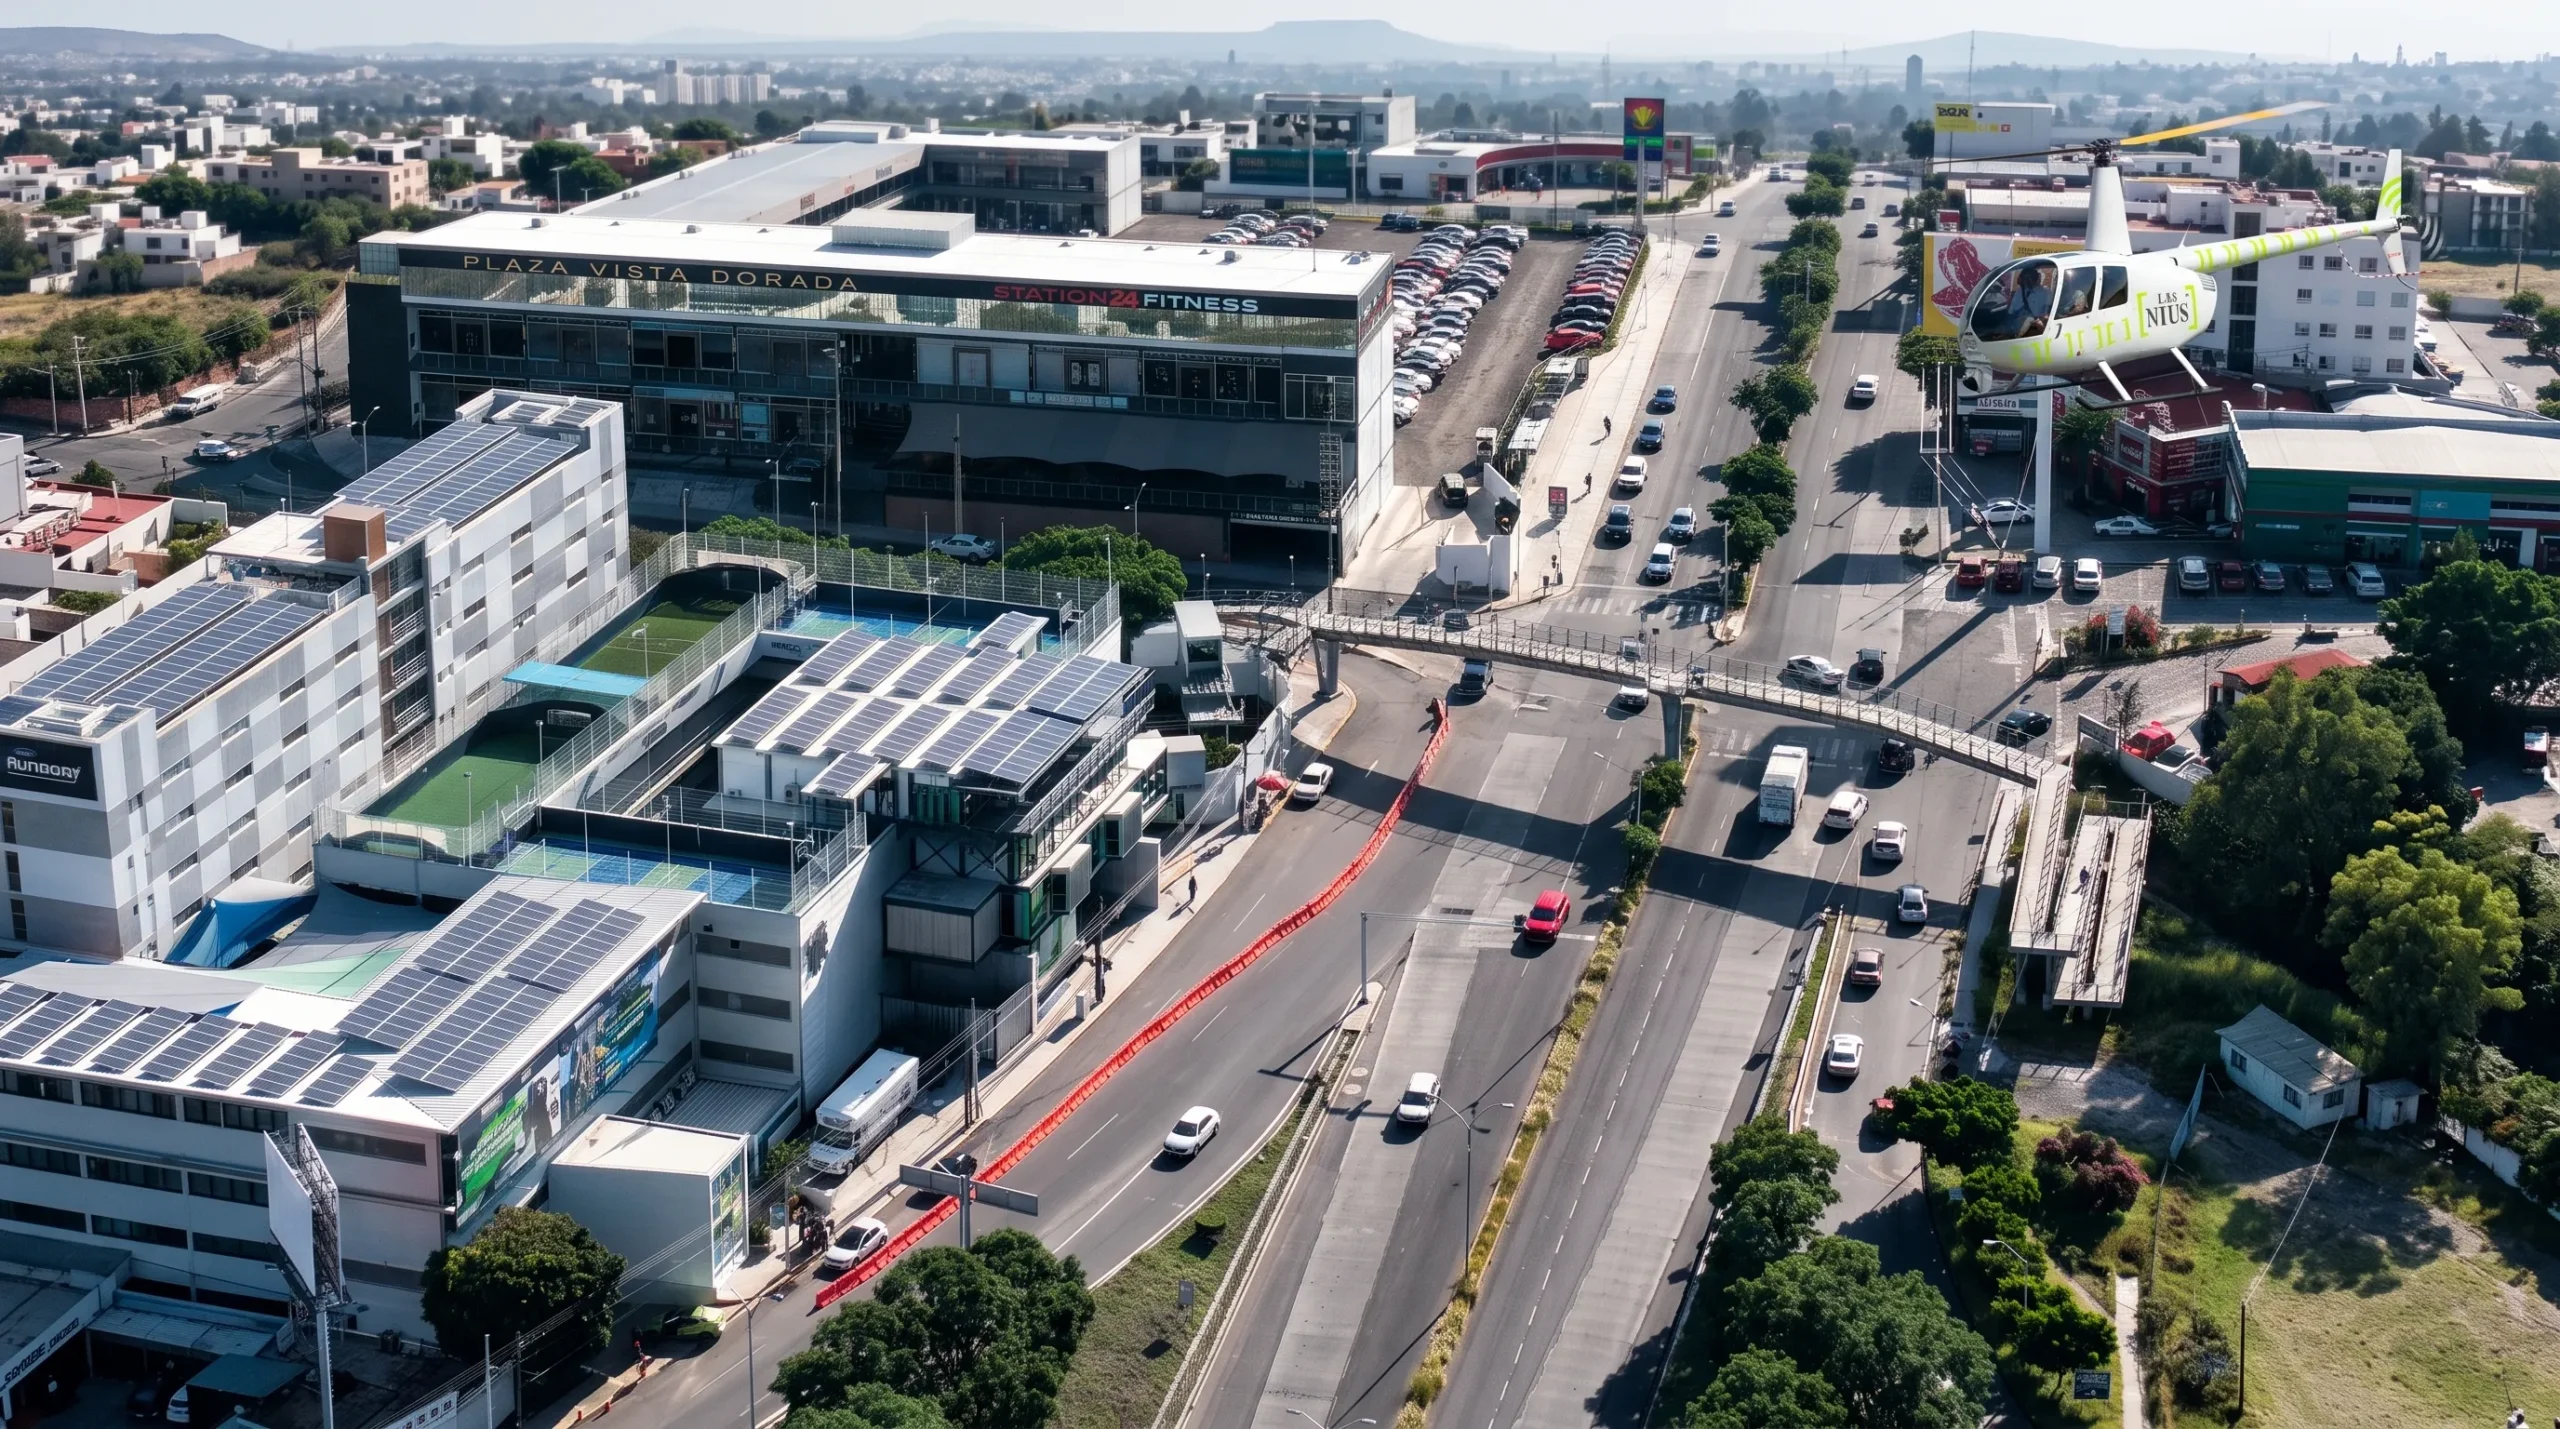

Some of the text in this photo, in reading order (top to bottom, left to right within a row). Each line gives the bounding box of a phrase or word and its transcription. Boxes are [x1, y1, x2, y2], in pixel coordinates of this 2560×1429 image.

[463, 255, 858, 292] PLAZA VISTA DORADA
[2145, 302, 2189, 328] NIUS
